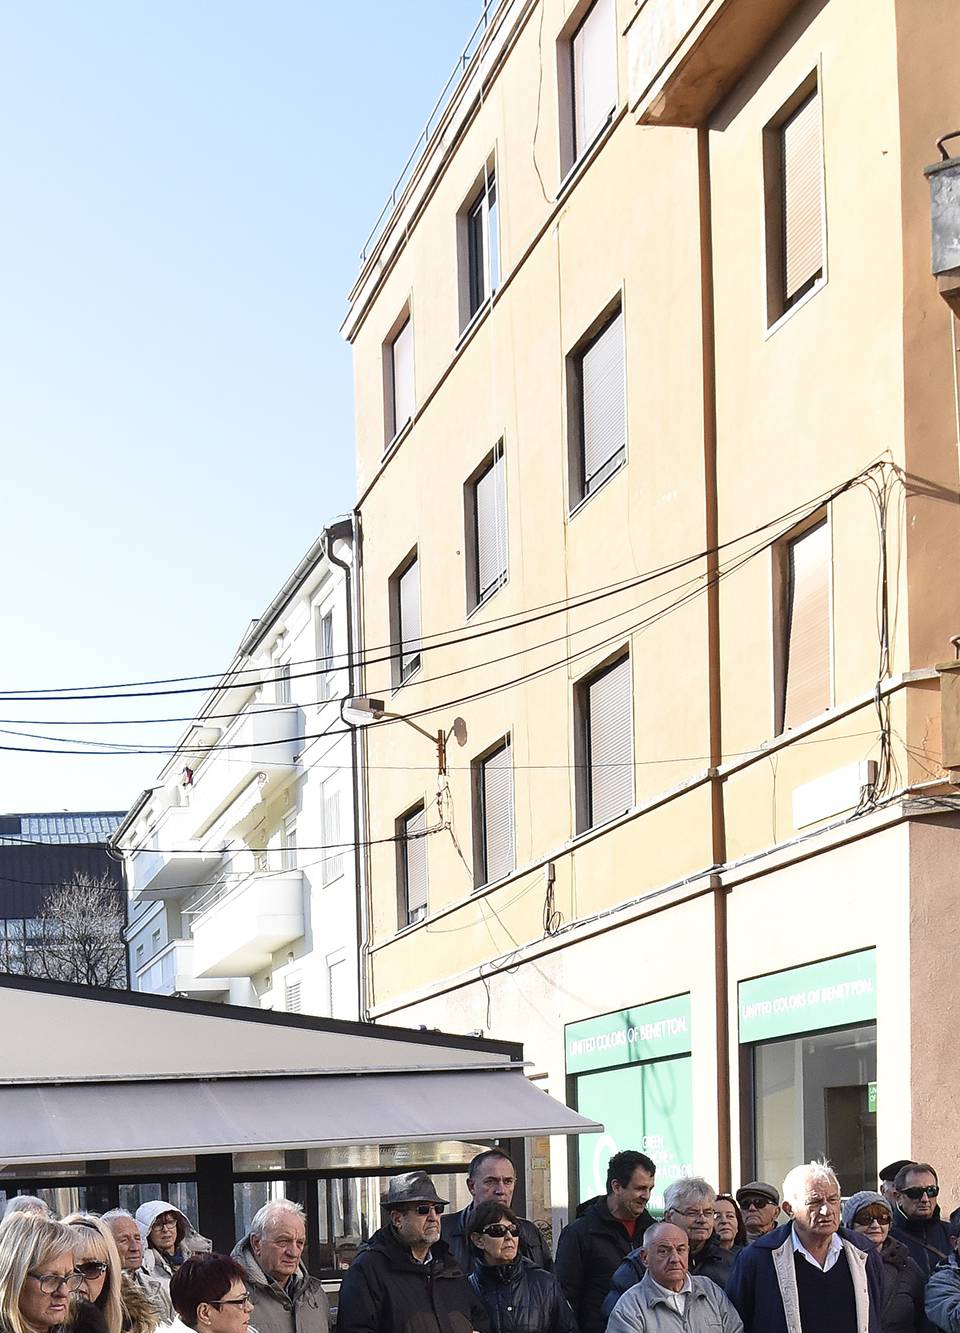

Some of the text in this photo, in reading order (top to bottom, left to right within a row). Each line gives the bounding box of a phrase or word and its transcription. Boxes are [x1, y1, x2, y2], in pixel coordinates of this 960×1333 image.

[742, 1000, 772, 1018] UNITED
[773, 991, 807, 1013] COLORS
[807, 988, 820, 1005] OF
[569, 1038, 596, 1056] UNITED
[596, 1029, 627, 1049] COLORS
[627, 1026, 639, 1043] OF
